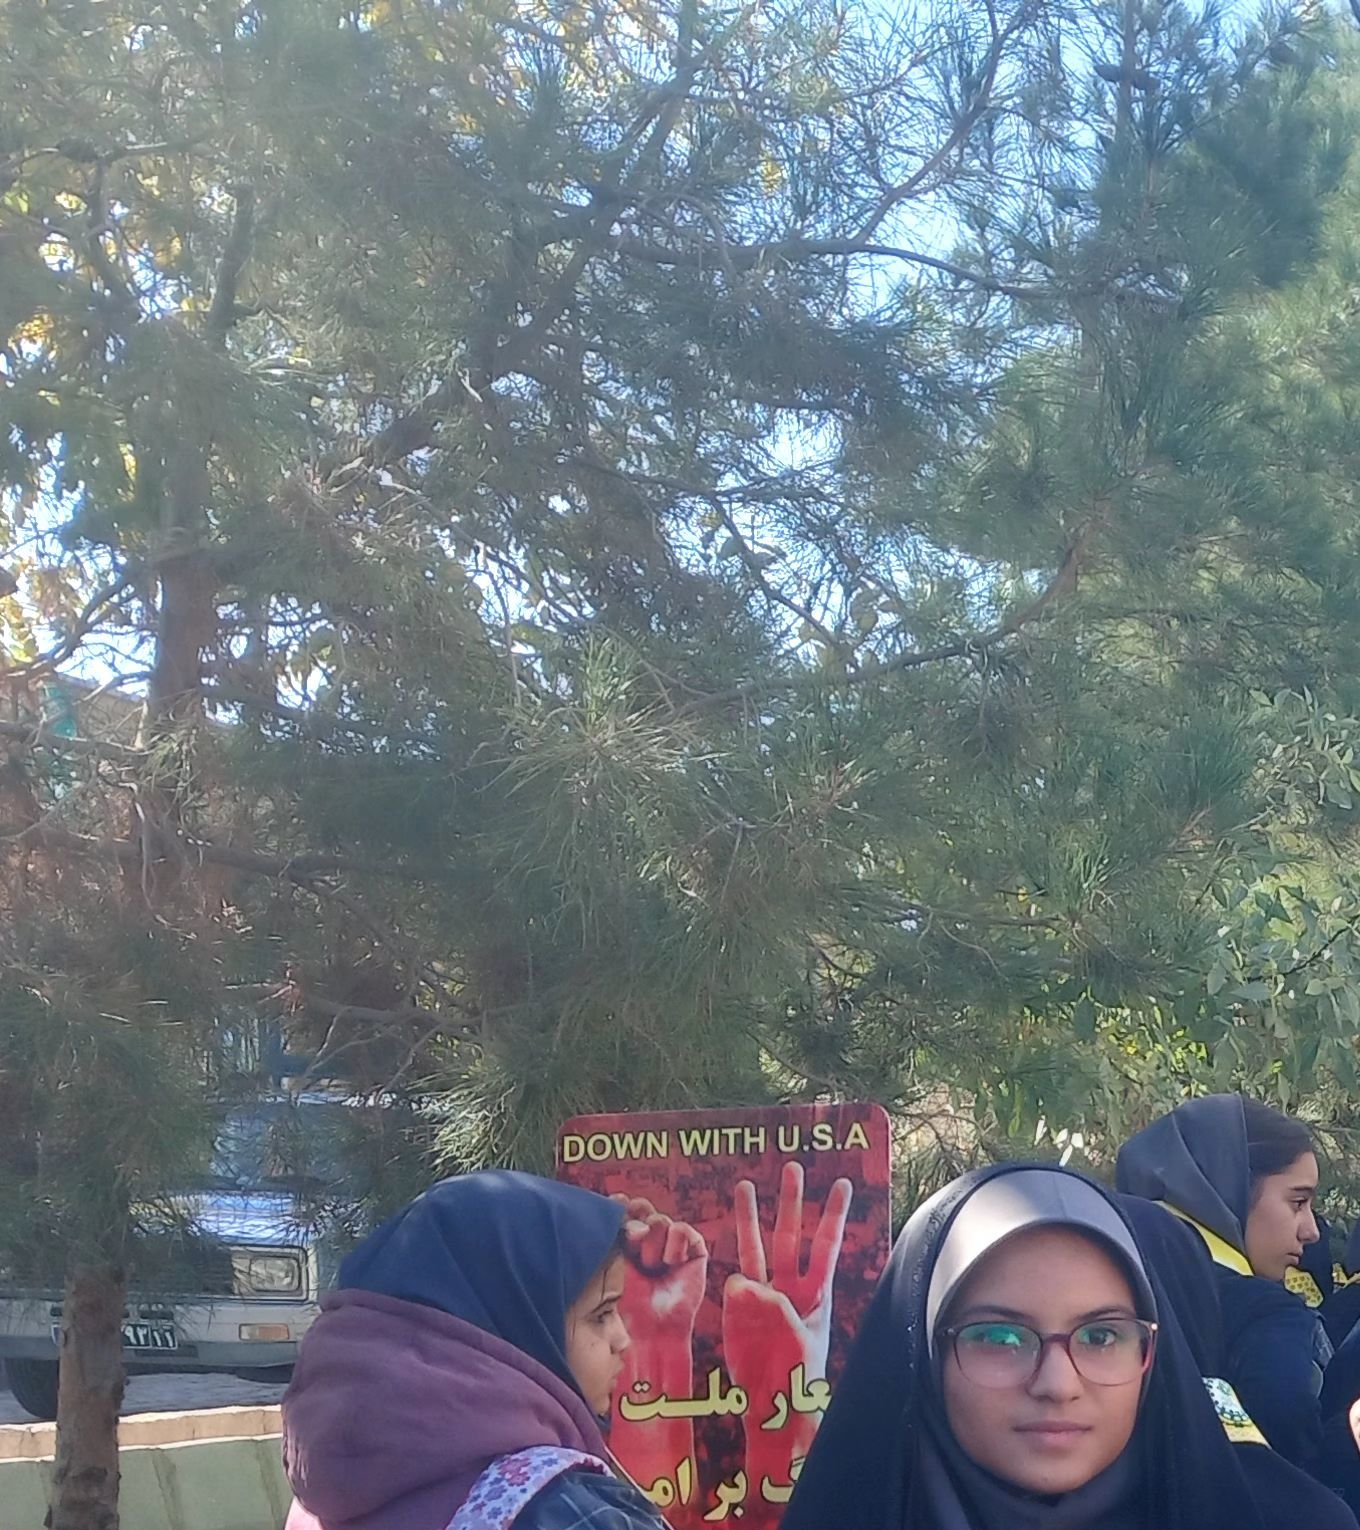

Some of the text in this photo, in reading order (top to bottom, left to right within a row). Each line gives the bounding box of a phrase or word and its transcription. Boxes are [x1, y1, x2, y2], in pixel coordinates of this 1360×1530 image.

[562, 1121, 870, 1164] DOWN WITH U.S.A
[619, 1364, 832, 1431] عار ملت
[703, 1468, 748, 1521] بر
